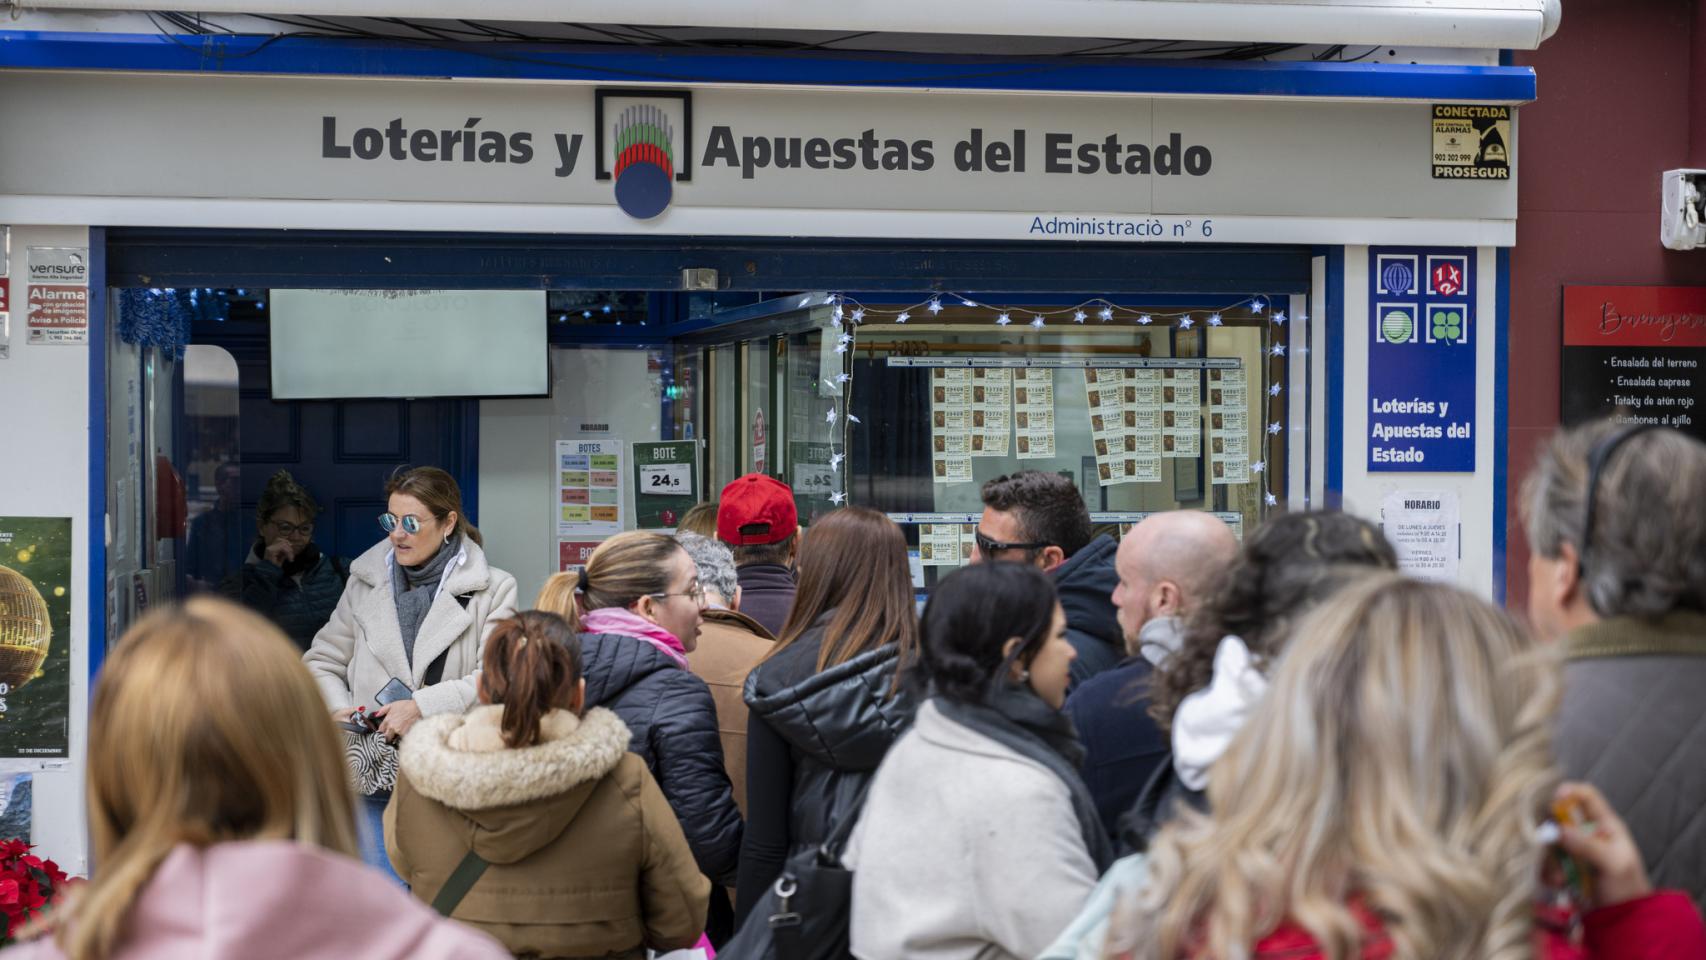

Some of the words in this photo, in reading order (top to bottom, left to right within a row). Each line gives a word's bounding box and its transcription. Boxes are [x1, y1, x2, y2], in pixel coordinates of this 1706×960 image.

[1435, 106, 1508, 118] CONECTADA
[322, 116, 534, 164] Loterías
[554, 133, 584, 178] y
[701, 125, 935, 179] Apuestas
[954, 128, 1026, 172] del
[1045, 132, 1212, 176] Estado
[1435, 153, 1446, 161] 902
[1448, 154, 1458, 162] 202
[1435, 167, 1508, 178] PROSEGUR
[1202, 220, 1213, 237] 6
[30, 265, 85, 274] verisure
[30, 287, 85, 300] Alarma
[55, 301, 85, 309] grabación
[1611, 356, 1650, 368] Ensalada
[1652, 356, 1664, 368] del
[1667, 358, 1698, 368] terreno
[1617, 376, 1656, 386] Ensalada
[1658, 378, 1691, 390] caprese
[1372, 398, 1435, 413] Loterías
[1439, 401, 1449, 418] y
[1614, 395, 1641, 408] Tataky
[1644, 395, 1654, 405] de
[1656, 396, 1675, 406] atún
[1677, 398, 1694, 408] rojo
[1615, 414, 1659, 425] Gambones
[1661, 414, 1669, 424] al
[1672, 414, 1692, 428] ajillo
[1372, 423, 1442, 441] Apuestas
[1447, 422, 1470, 438] del
[578, 443, 601, 453] BOTES
[653, 447, 676, 459] BOTE
[1372, 446, 1425, 463] Estado
[651, 474, 680, 487] 24,5
[1404, 500, 1441, 510] HORARIO
